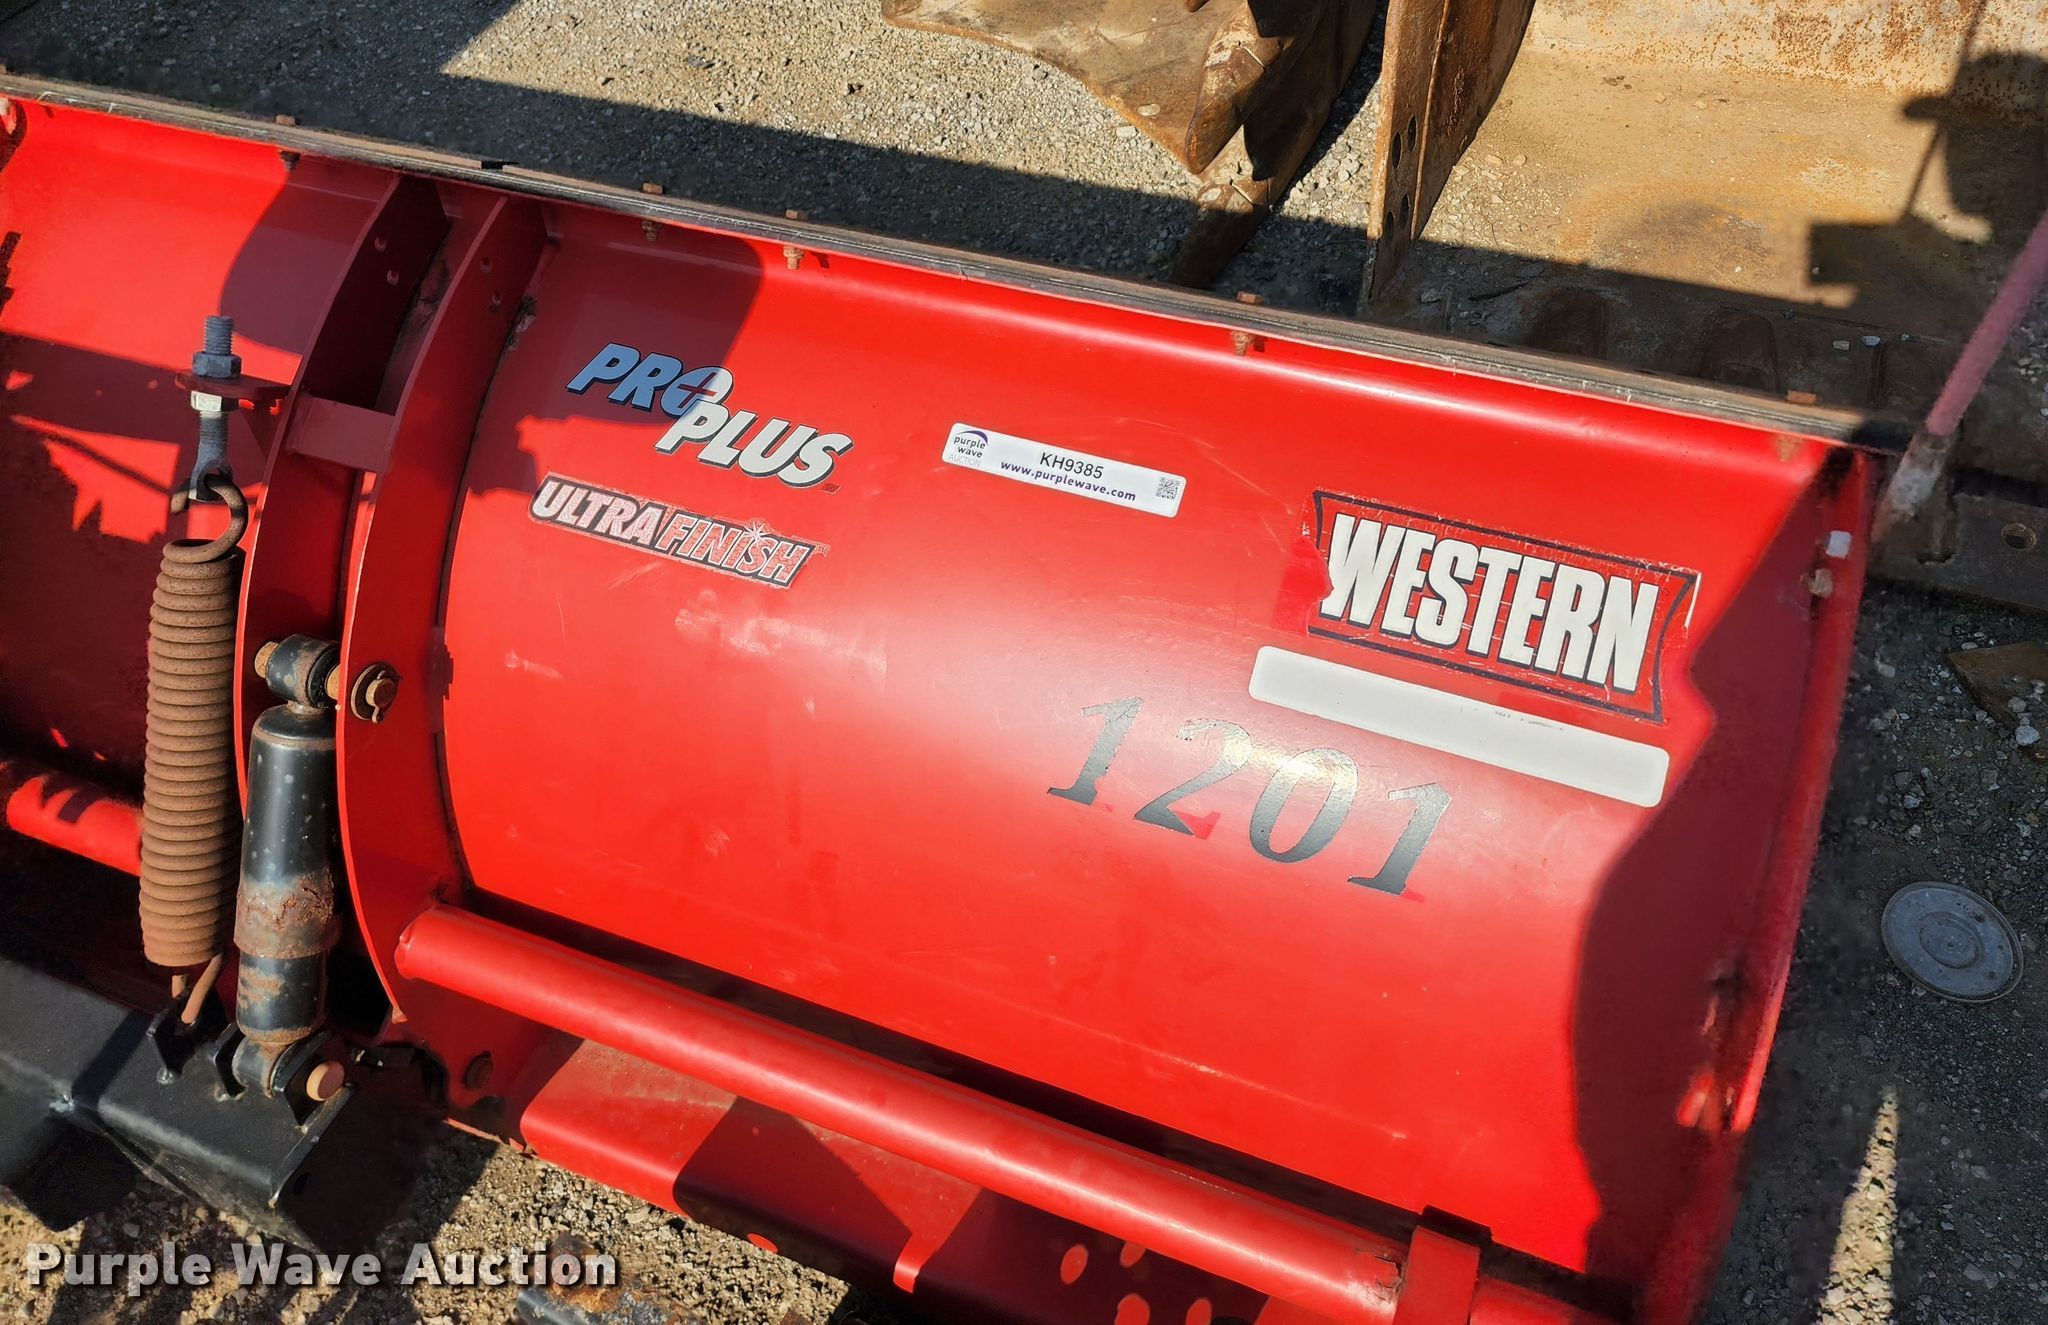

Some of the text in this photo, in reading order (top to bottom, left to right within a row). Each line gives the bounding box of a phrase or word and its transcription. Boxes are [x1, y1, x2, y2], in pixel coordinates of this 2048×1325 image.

[565, 342, 733, 418] PRO
[653, 398, 855, 487] PLUS
[947, 453, 982, 468] AUCTION
[953, 435, 987, 451] purple
[958, 446, 983, 459] wave
[1000, 461, 1137, 502] www.purplewave.com
[1040, 452, 1104, 479] KH9385
[1319, 512, 1660, 695] WESTERN
[1046, 696, 1453, 896] 1201
